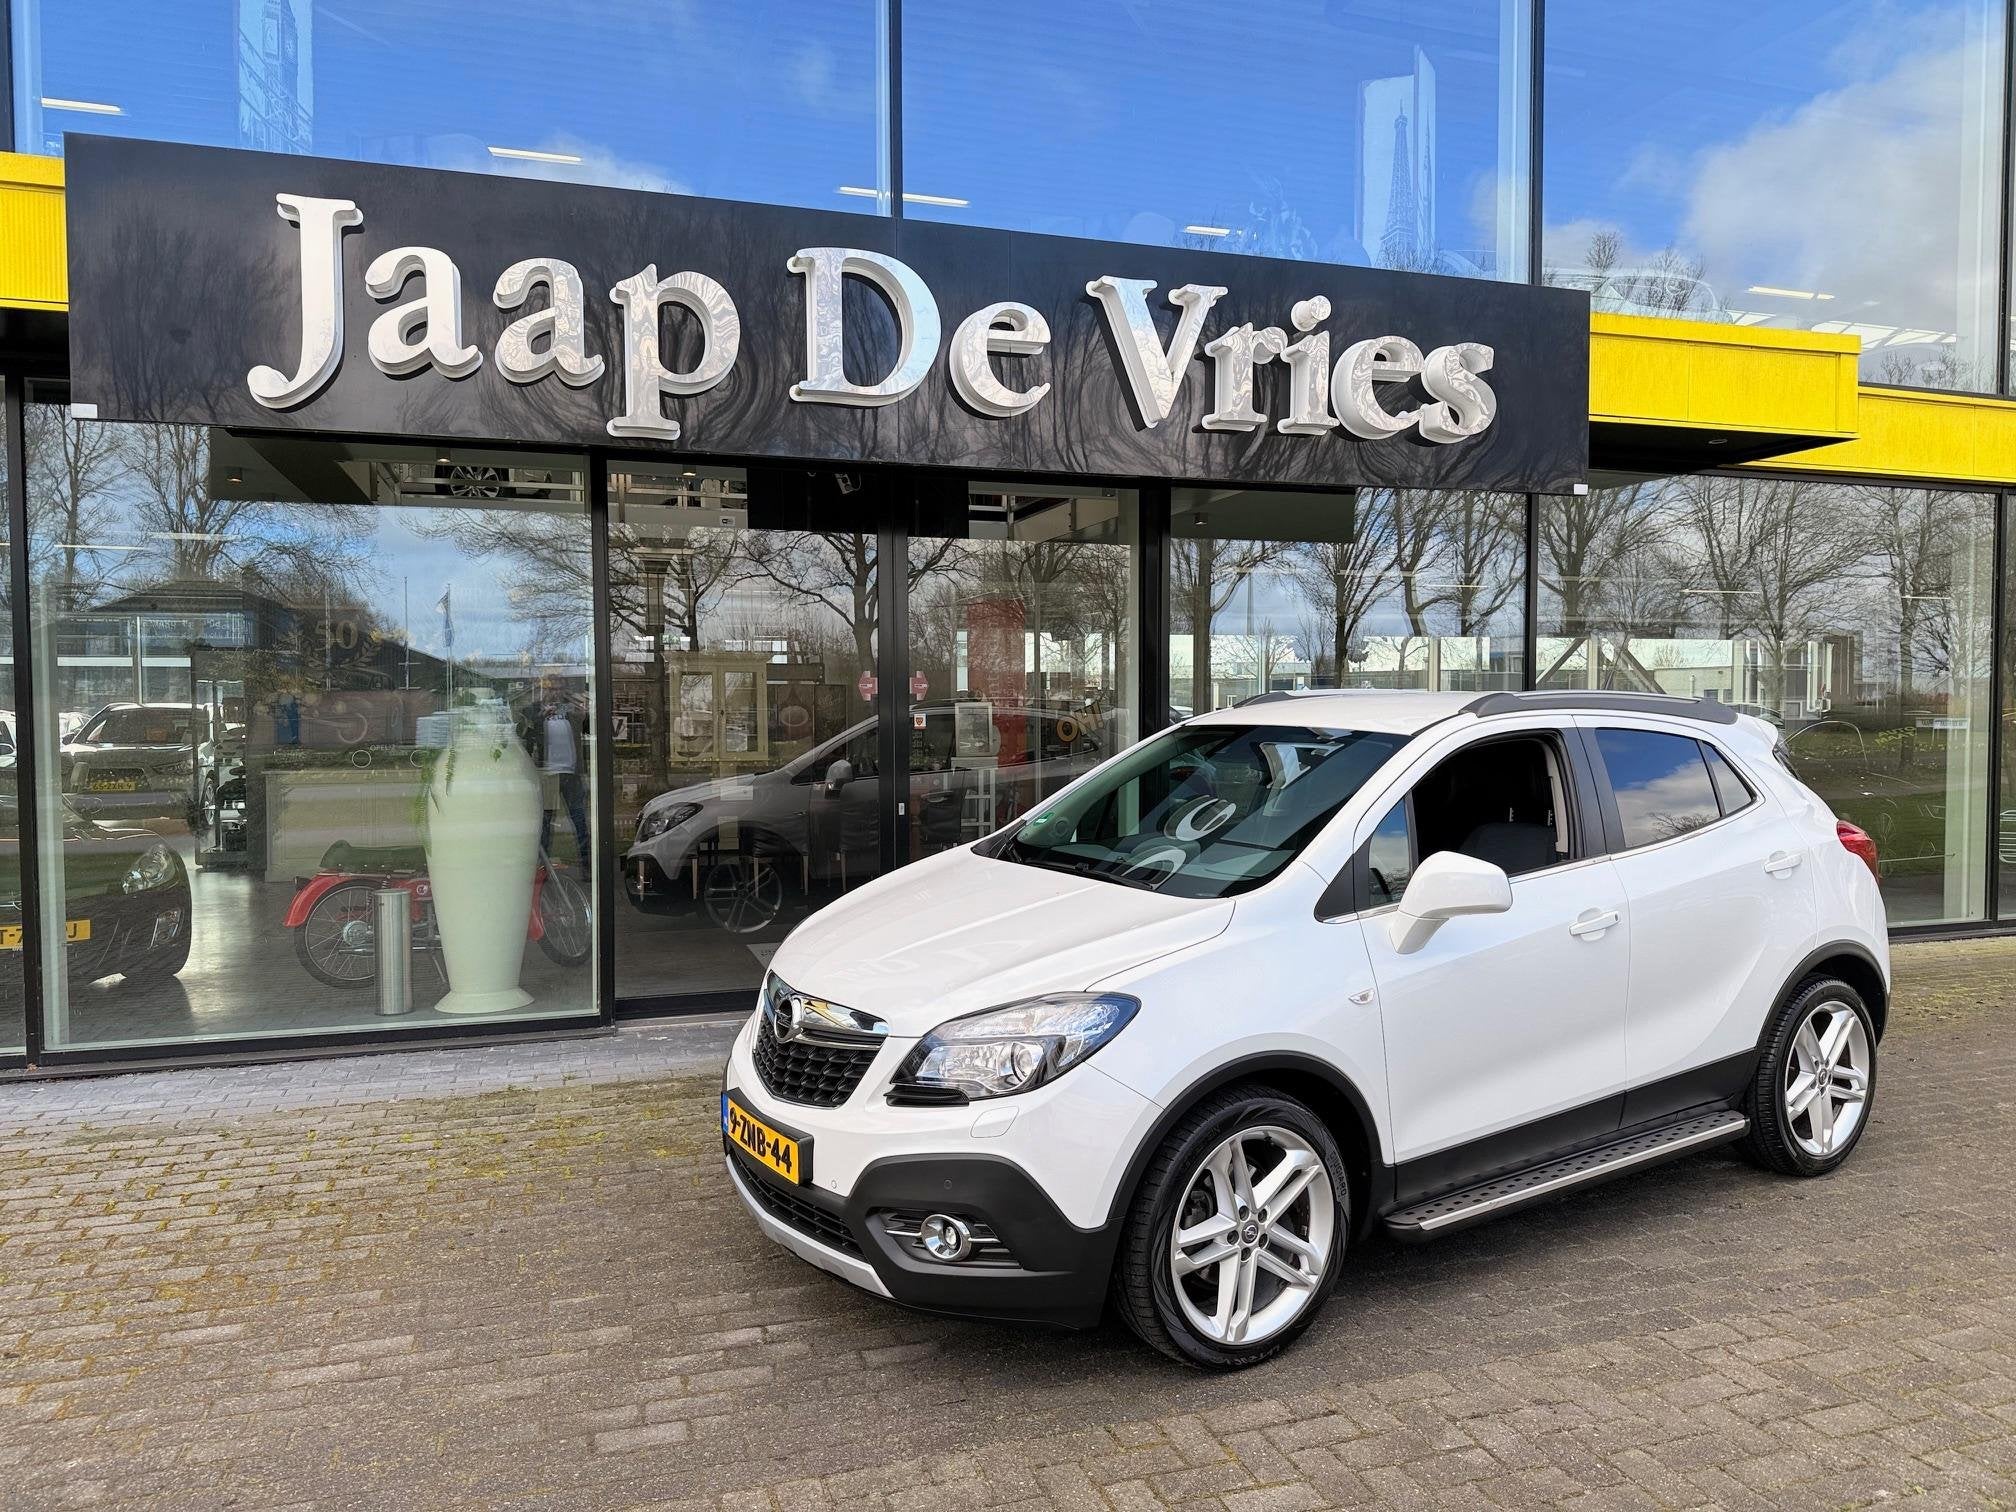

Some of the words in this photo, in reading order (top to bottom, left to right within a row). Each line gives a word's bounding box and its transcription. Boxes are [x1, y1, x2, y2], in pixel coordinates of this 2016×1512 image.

[247, 192, 741, 440] Jaap
[787, 246, 1051, 418] De
[1085, 274, 1496, 445] Vries
[729, 1107, 792, 1174] 9-ZNB-44
